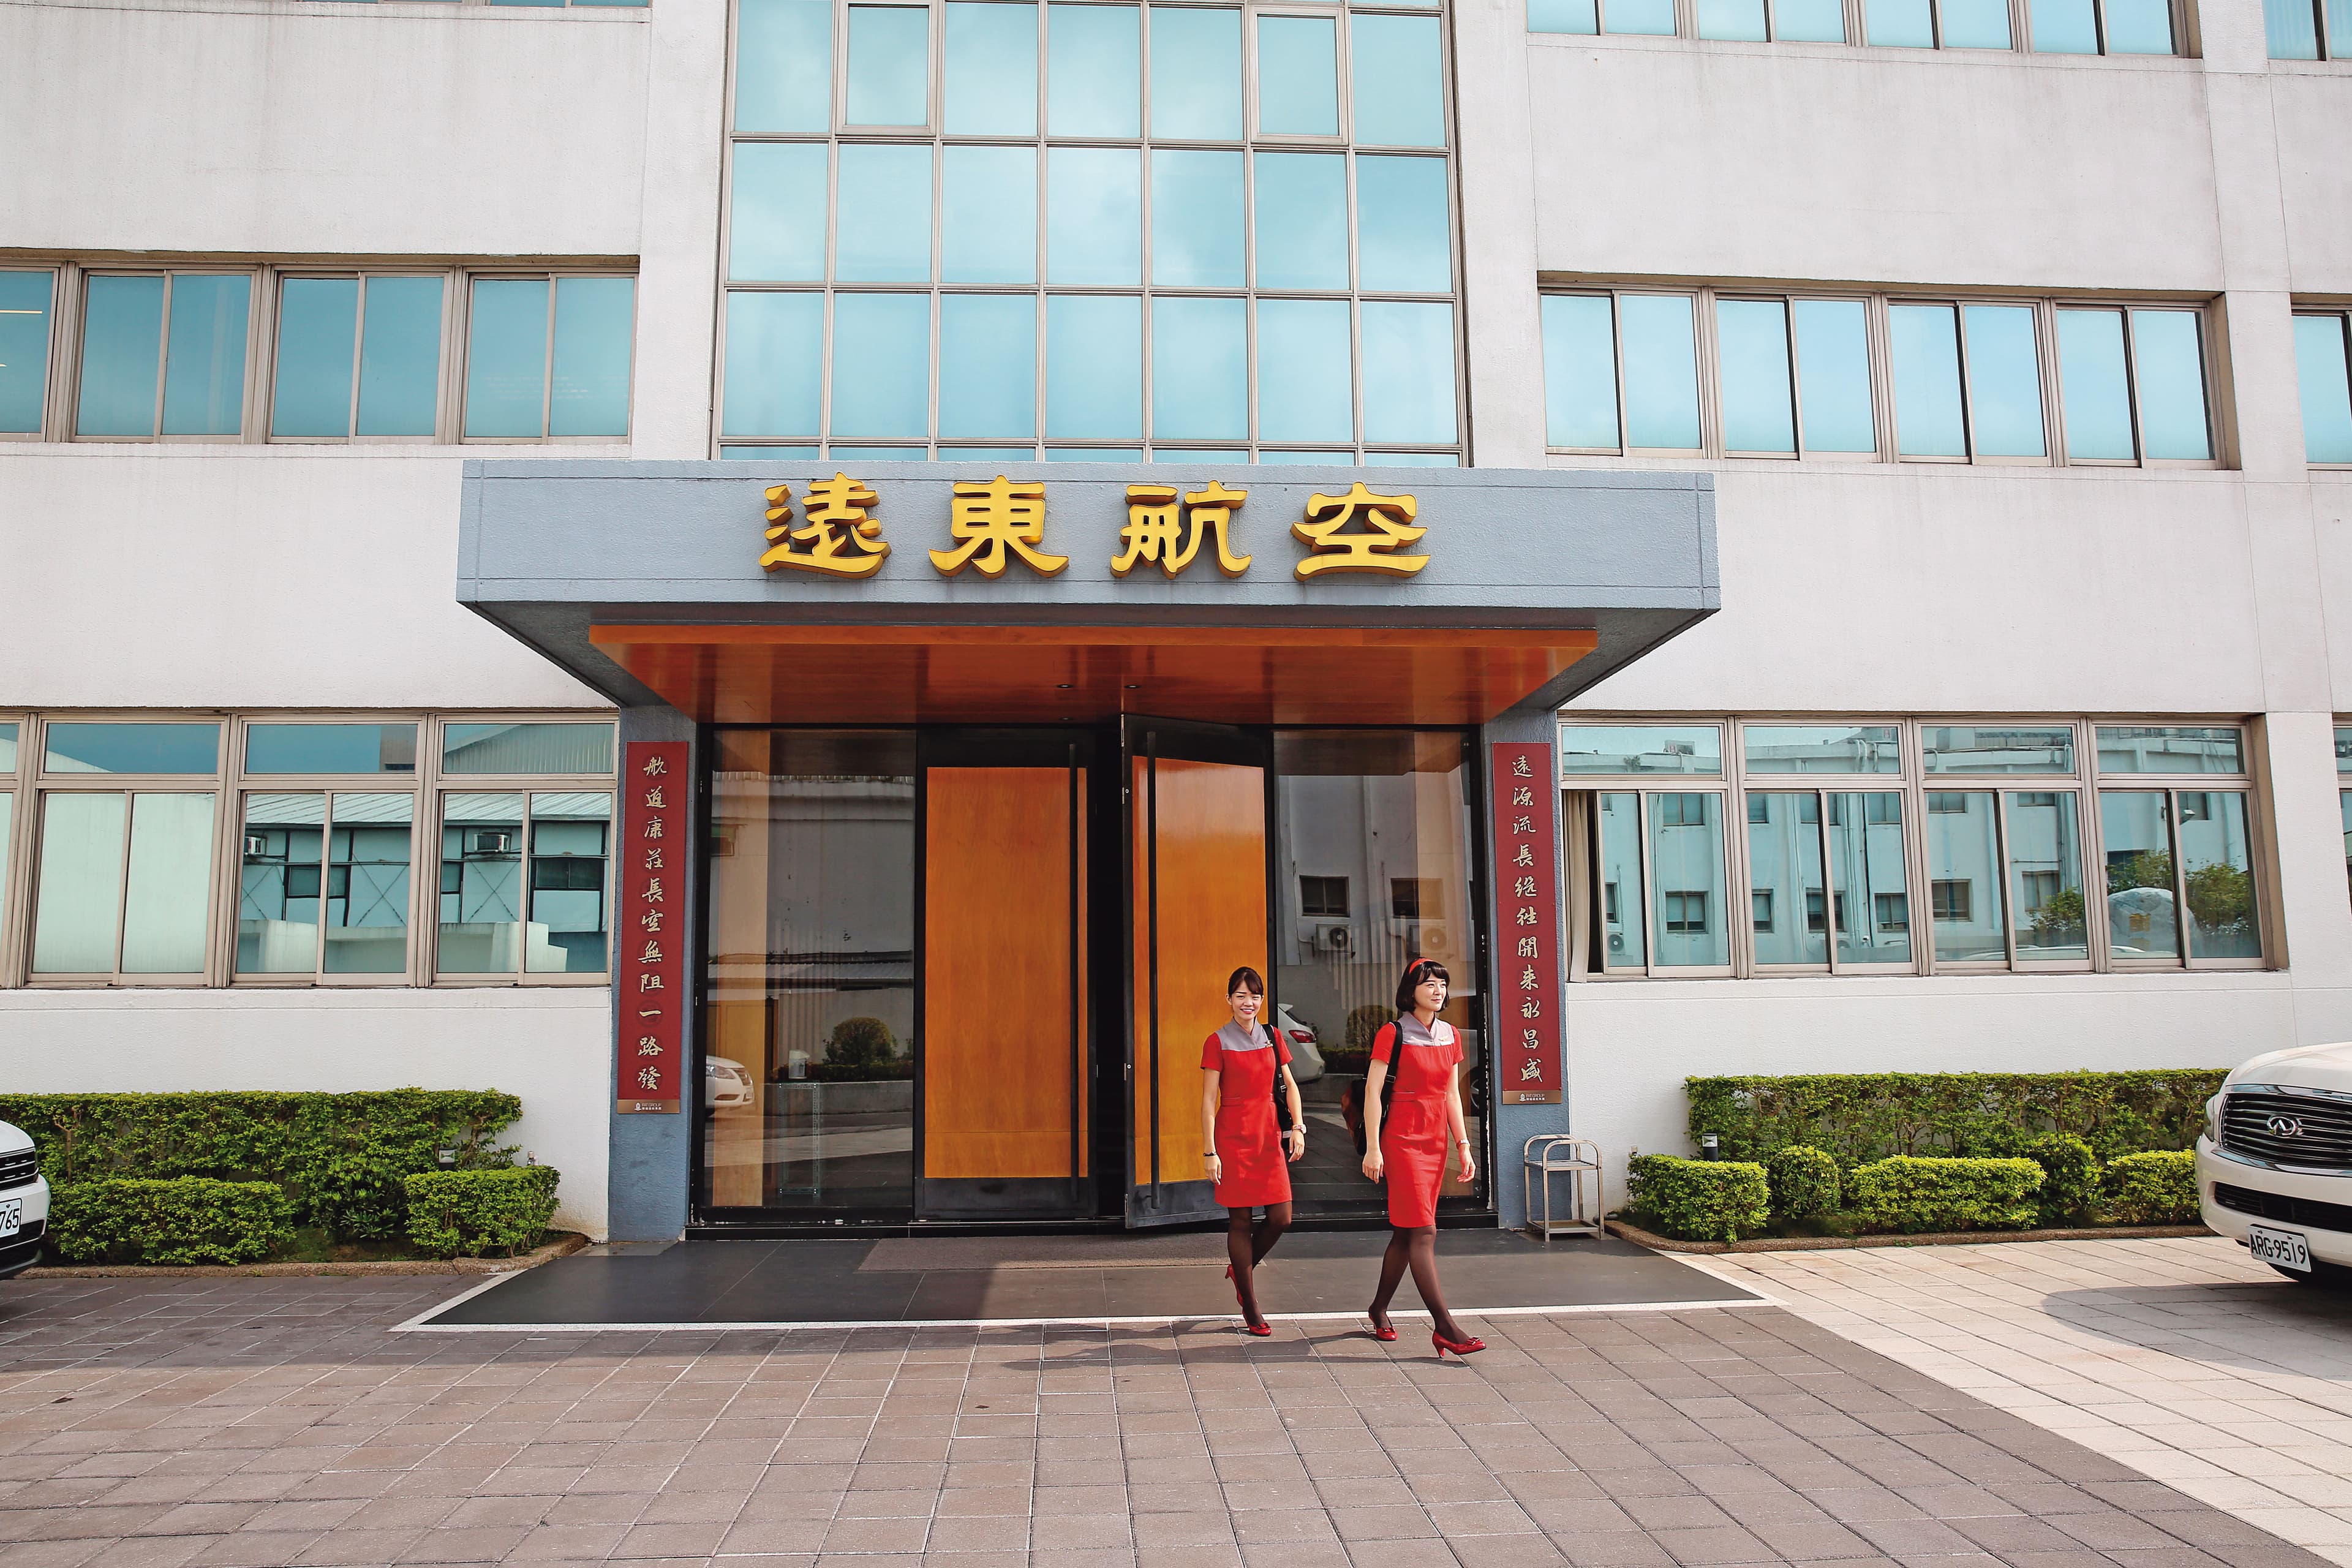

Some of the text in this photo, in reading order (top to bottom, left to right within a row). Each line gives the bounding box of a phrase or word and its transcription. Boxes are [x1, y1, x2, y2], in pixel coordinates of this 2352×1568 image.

[758, 471, 1431, 581] 遠東航空
[2250, 1234, 2306, 1264] ARG-9519
